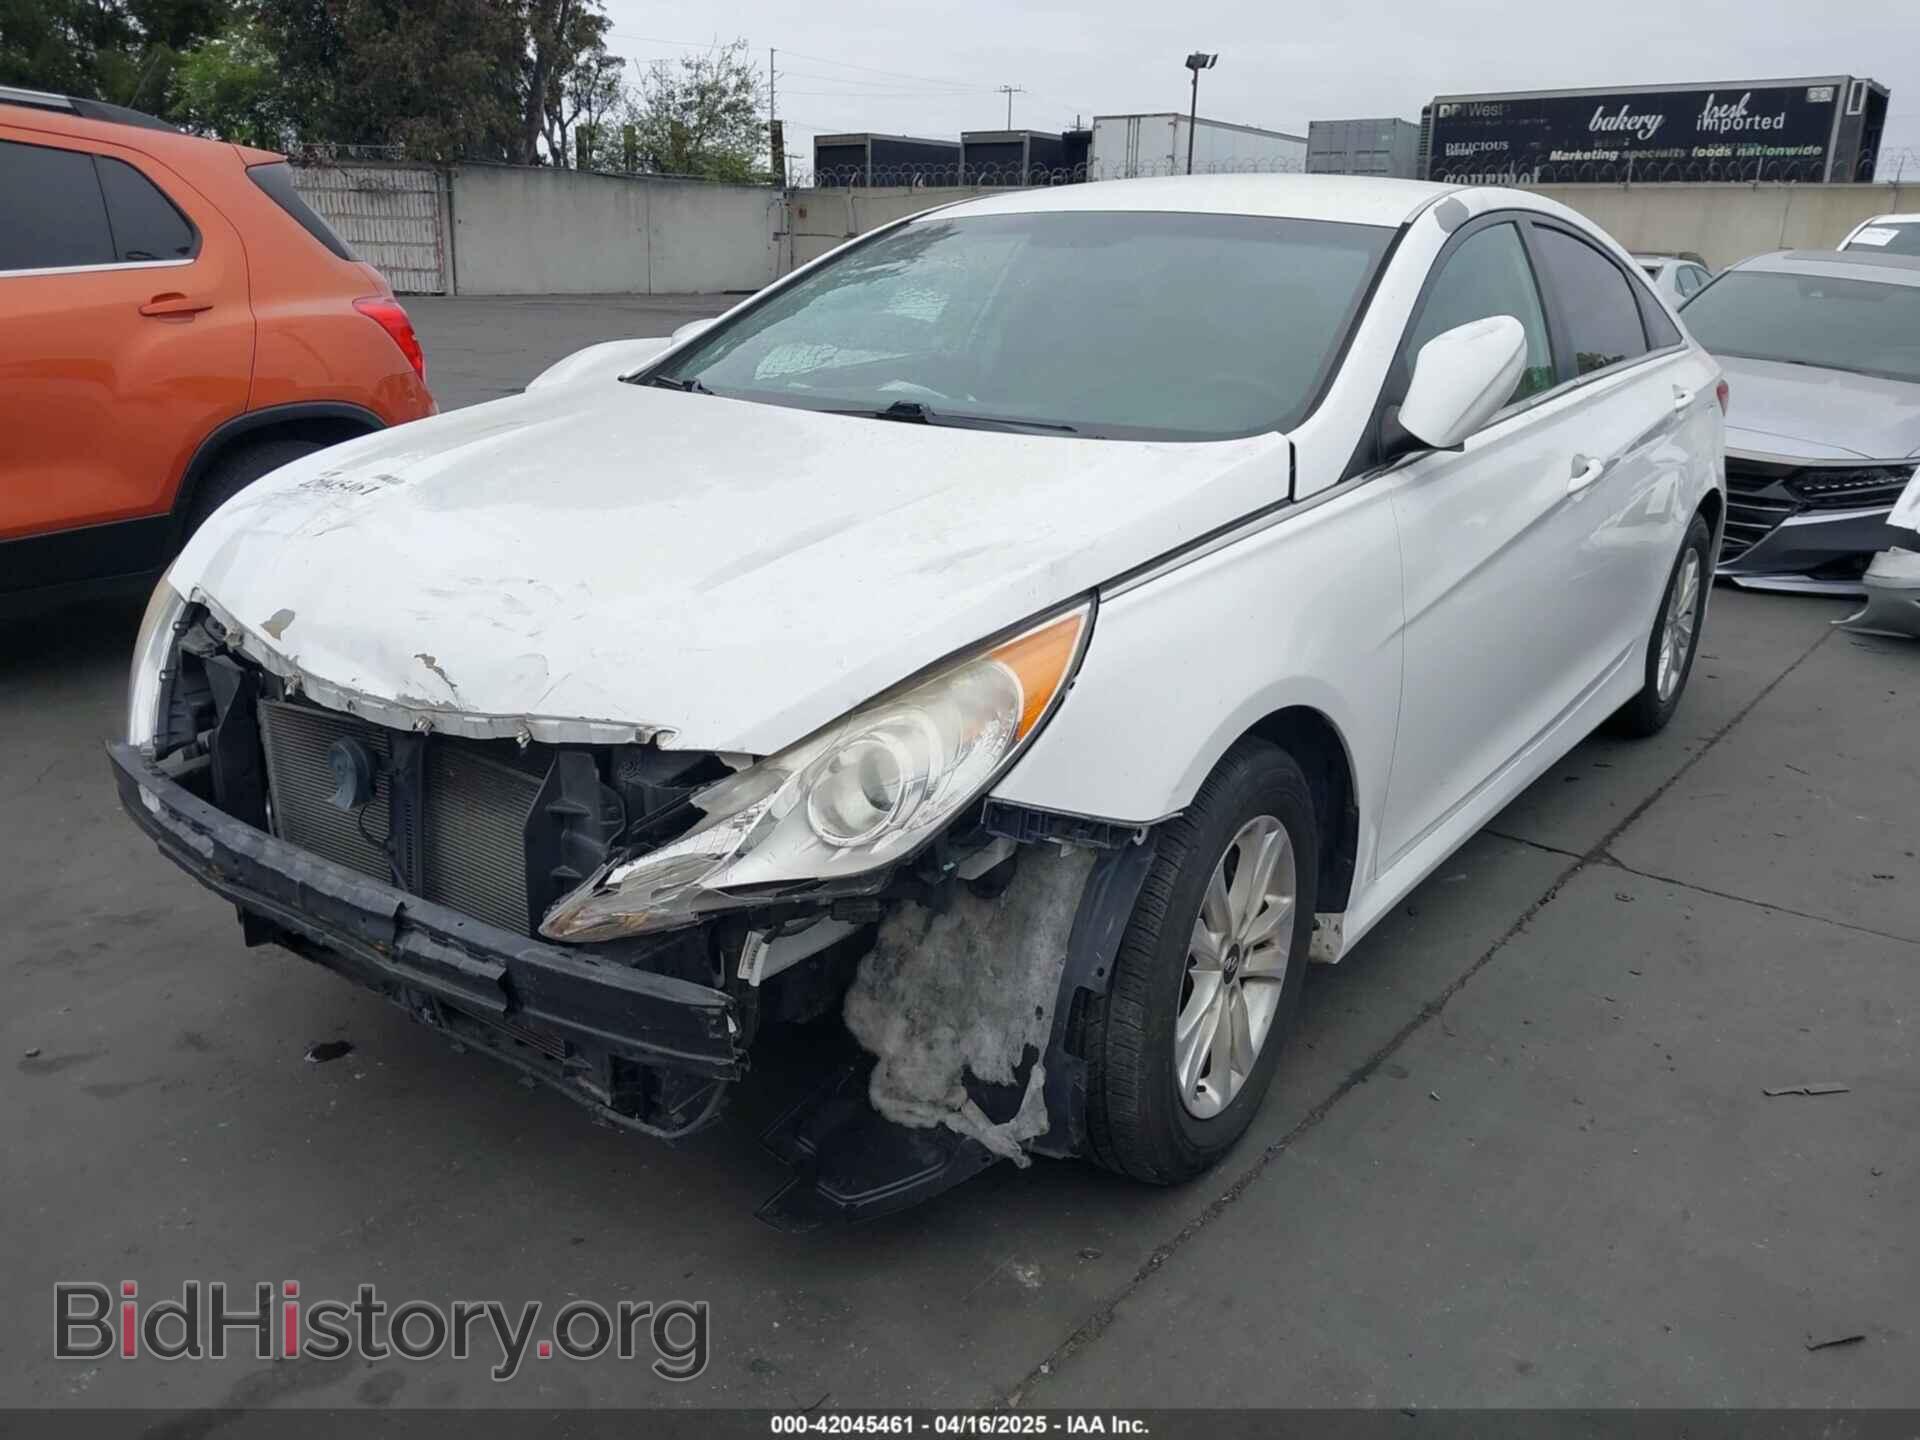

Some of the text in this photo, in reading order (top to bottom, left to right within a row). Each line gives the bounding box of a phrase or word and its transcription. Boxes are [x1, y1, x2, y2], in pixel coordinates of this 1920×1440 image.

[1702, 91, 1751, 118] fresh
[1588, 104, 1664, 140] bakery
[1696, 112, 1786, 134] imported
[1445, 141, 1509, 153] DELICIOUS
[1549, 149, 1619, 161] Marketing
[1692, 146, 1732, 157] foods
[1736, 145, 1823, 157] nationwide
